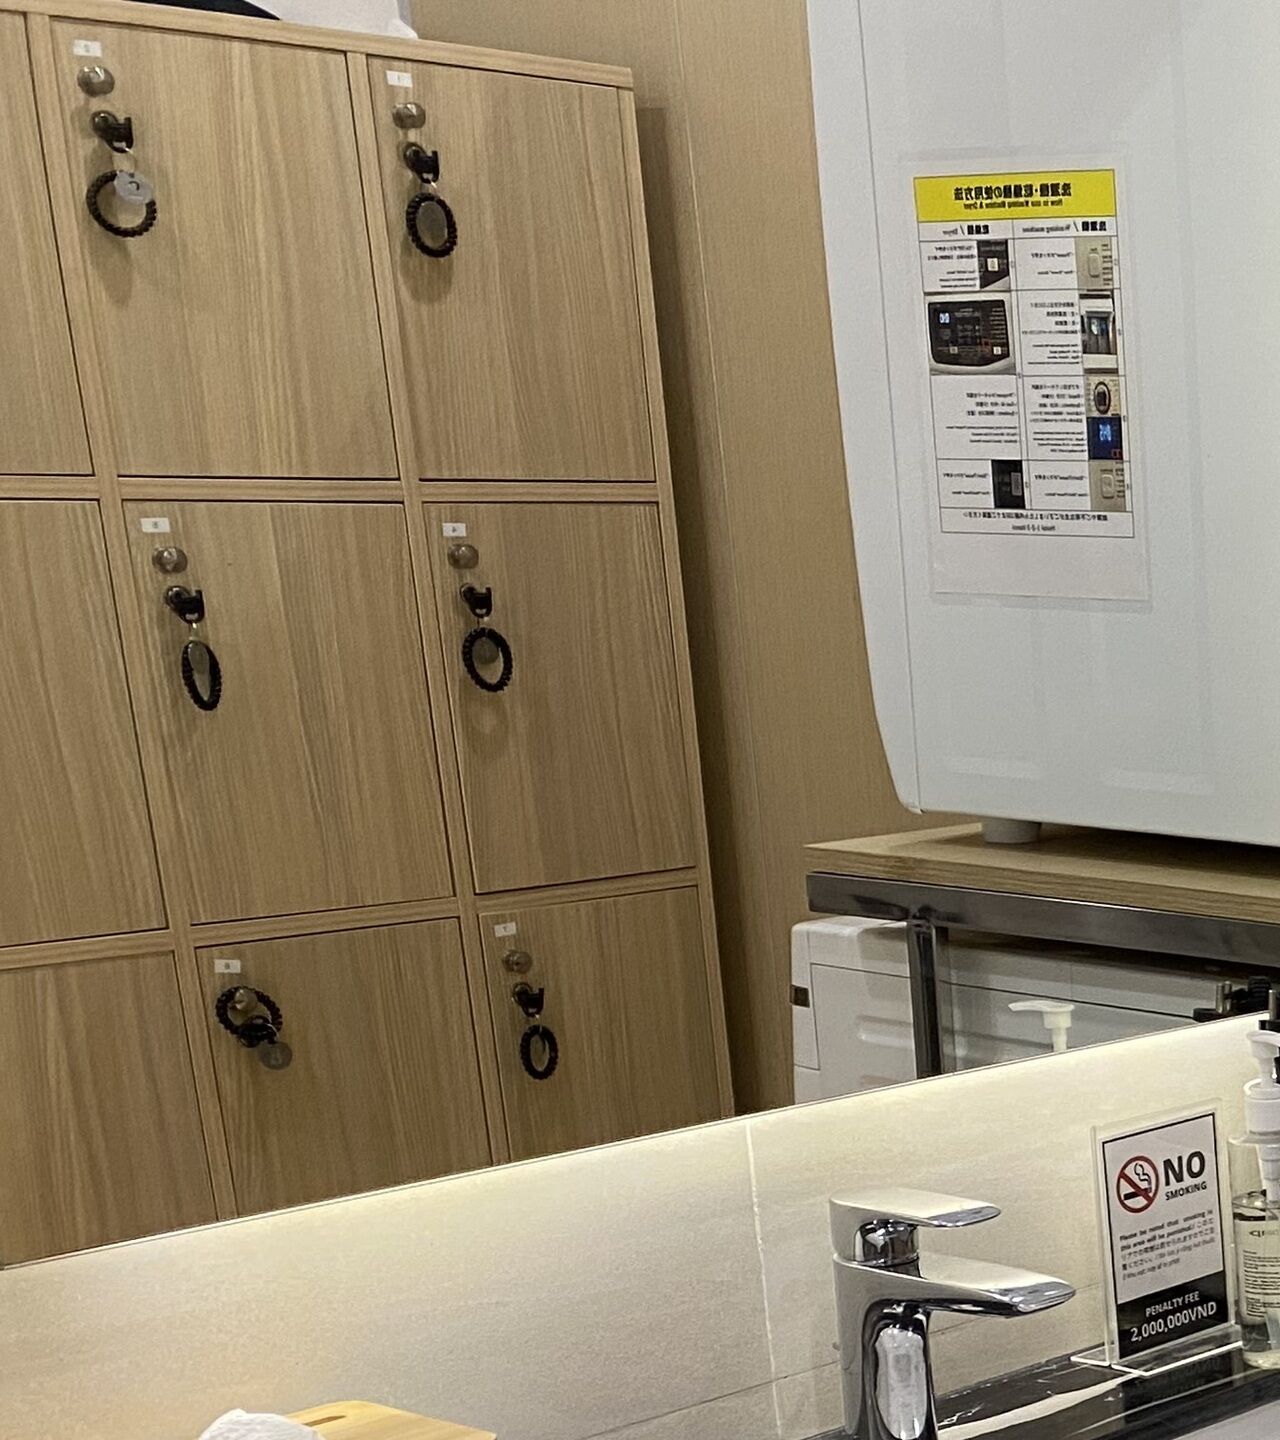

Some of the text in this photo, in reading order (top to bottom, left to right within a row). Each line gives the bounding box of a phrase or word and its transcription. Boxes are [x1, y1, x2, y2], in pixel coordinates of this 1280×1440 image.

[1163, 1150, 1206, 1187] NO
[1165, 1181, 1207, 1201] SMOKING
[1145, 1291, 1200, 1318] PENALTY FEE
[1130, 1301, 1217, 1341] 2,000,000VND
